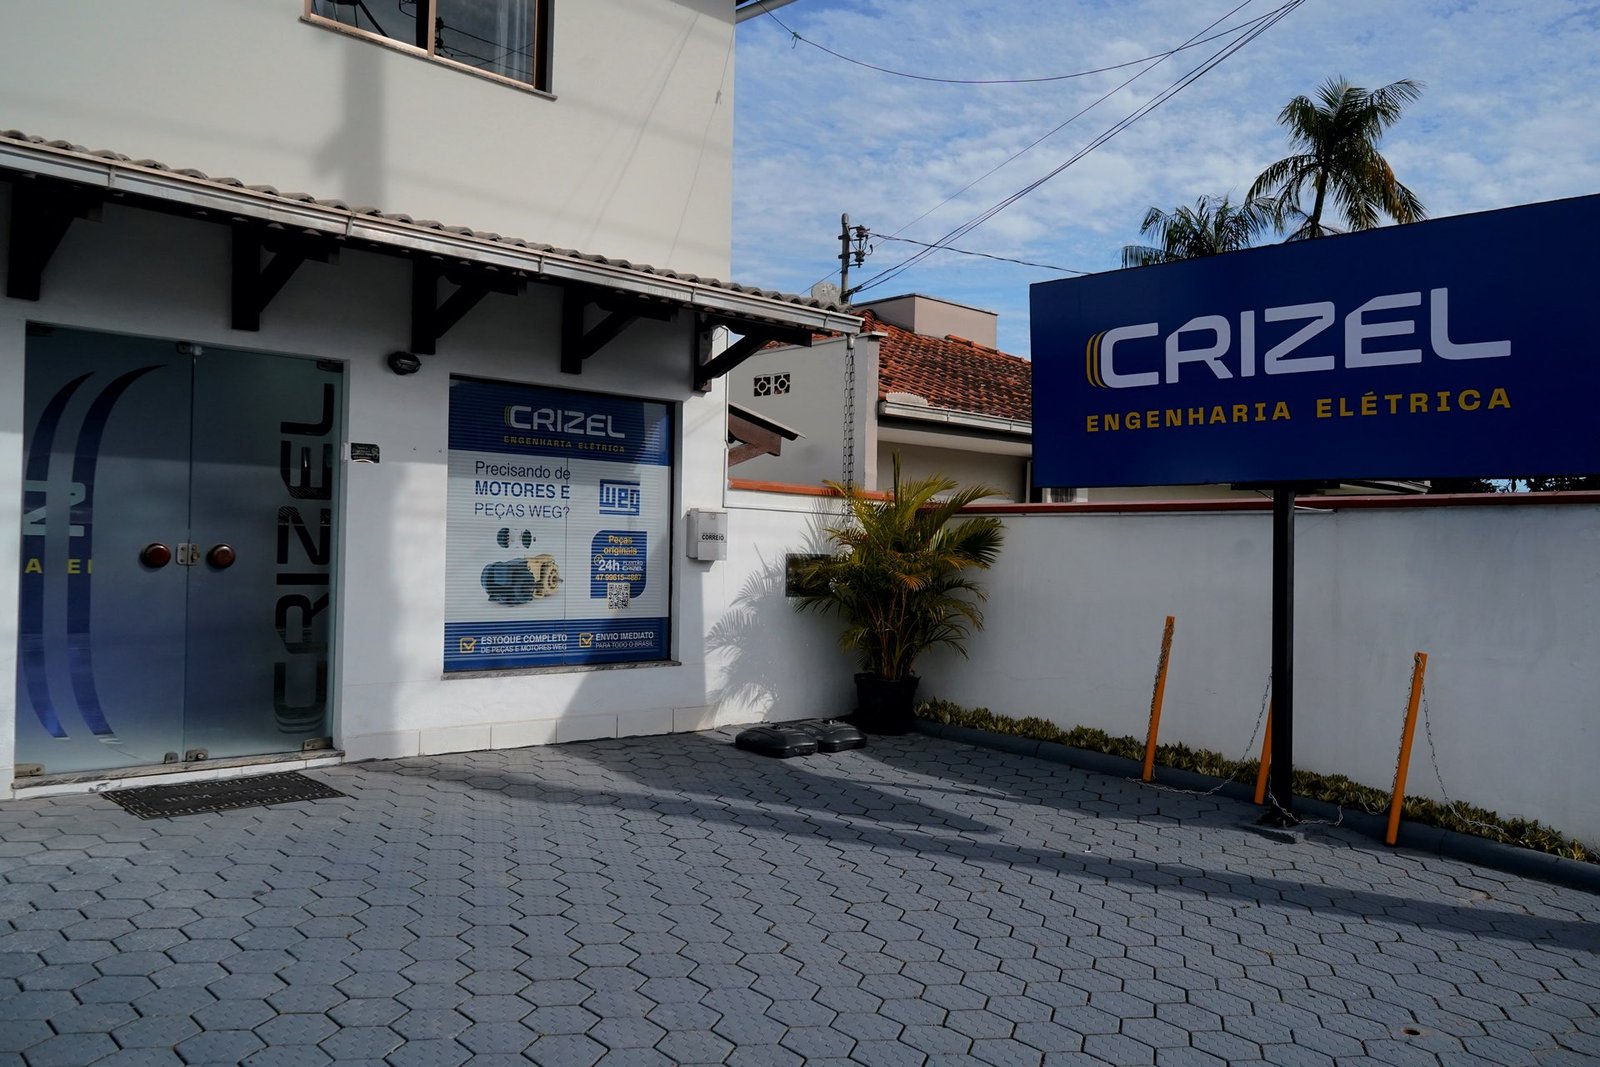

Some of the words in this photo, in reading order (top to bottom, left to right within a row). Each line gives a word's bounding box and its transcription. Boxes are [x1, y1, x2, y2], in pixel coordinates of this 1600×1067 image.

[1099, 287, 1512, 389] CRIZEL
[1086, 400, 1291, 433] ENGENHARIA
[1315, 387, 1512, 419] ELÉTRICA
[509, 405, 626, 439] CRIZEL
[503, 435, 573, 448] ENGENHARIA
[578, 441, 625, 453] ELÉTRICA
[475, 460, 551, 479] Precisando
[554, 466, 571, 480] de
[474, 480, 556, 499] MOTORES
[560, 485, 571, 500] E
[474, 502, 525, 519] PEÇAS
[528, 504, 570, 519] WEG?
[608, 535, 633, 545] Peças
[273, 383, 335, 720] CRIZEL
[603, 546, 638, 556] originais
[598, 559, 620, 571] 24h
[480, 635, 521, 645] ESTOQUE
[522, 633, 568, 643] COMPLETO
[595, 632, 619, 641] ENVIO
[620, 631, 654, 640] IMEDIATO
[491, 645, 514, 654] PEÇAS
[520, 644, 552, 652] MOTORES
[595, 641, 611, 649] PARA
